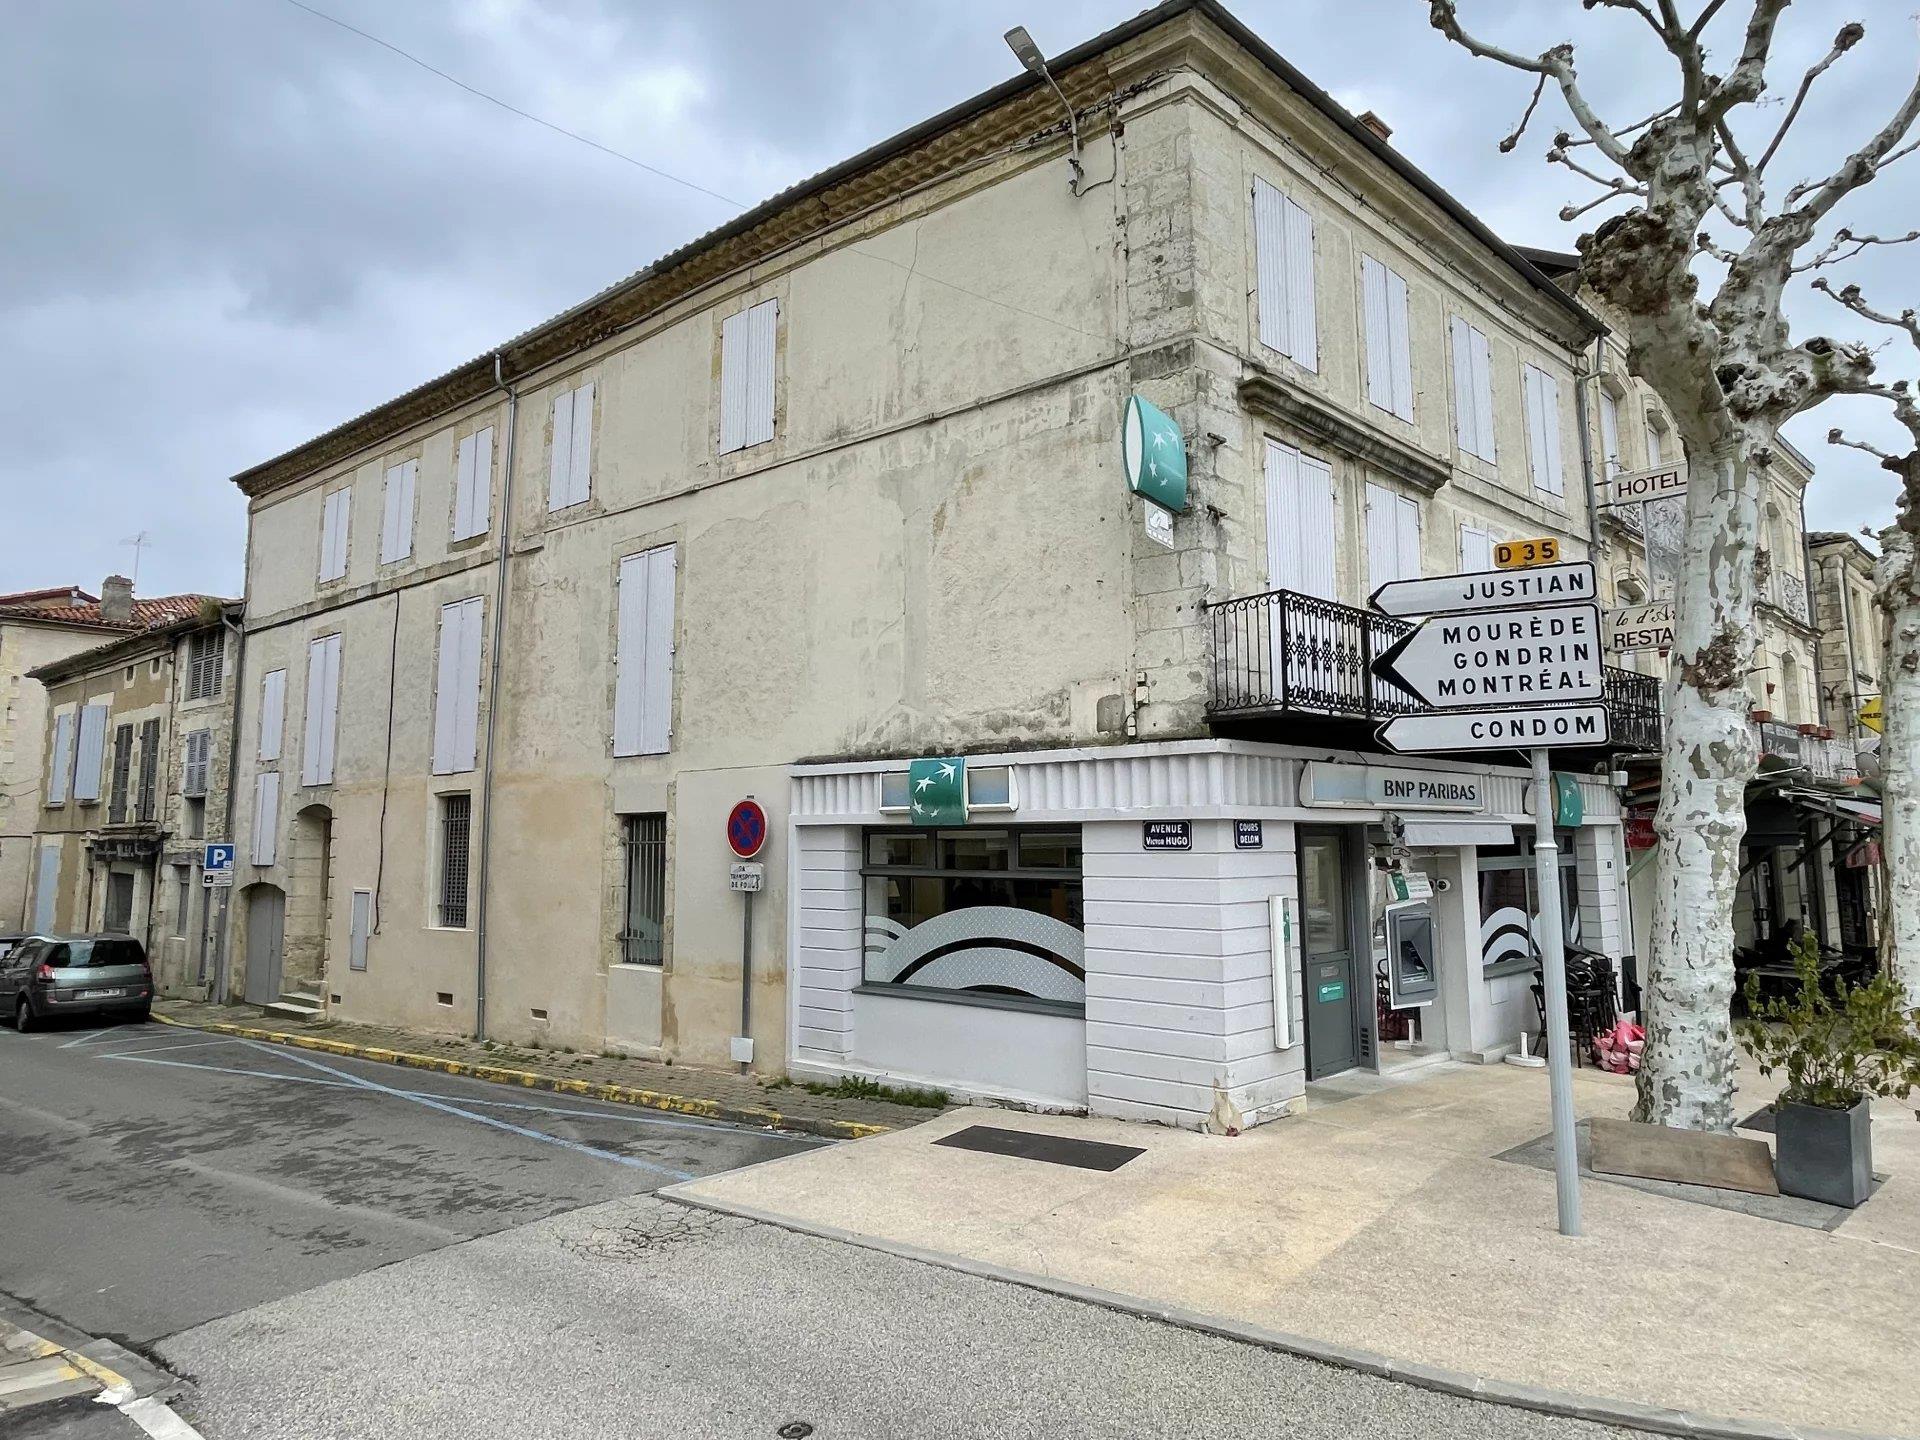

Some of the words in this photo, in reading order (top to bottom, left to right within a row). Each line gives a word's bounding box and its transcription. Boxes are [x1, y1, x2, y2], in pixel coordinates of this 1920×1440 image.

[1618, 471, 1687, 498] HOTEL
[1499, 546, 1512, 564] D
[1523, 542, 1555, 561] 35
[1463, 573, 1584, 600] JUSTIAN
[1443, 616, 1586, 645] MOURÈDE
[1613, 627, 1674, 649] RESTA
[1453, 643, 1589, 669] GONDRIN
[1438, 669, 1592, 697] MONTRÉAL
[1470, 715, 1596, 739] CONDOM
[1384, 780, 1415, 797] BNP
[1419, 782, 1476, 800] PARIBAS
[1150, 824, 1183, 834] AVENUE
[1239, 822, 1259, 832] COURS
[1165, 836, 1188, 846] HUGO
